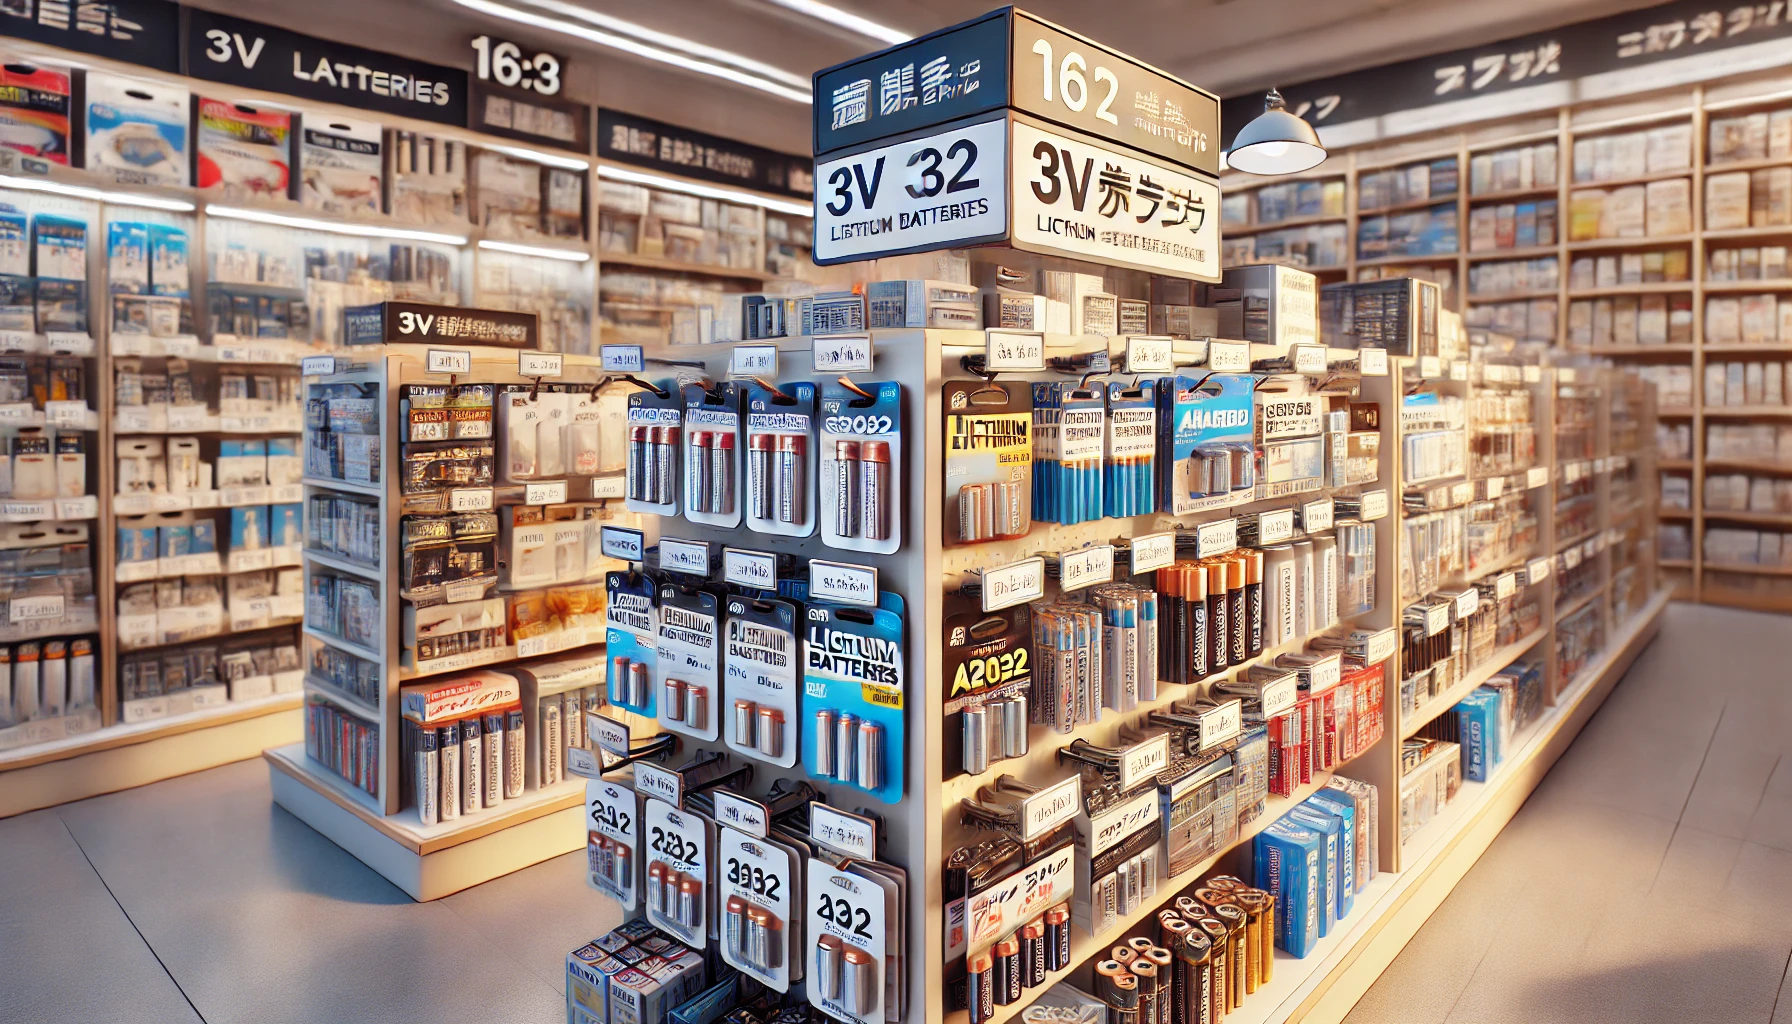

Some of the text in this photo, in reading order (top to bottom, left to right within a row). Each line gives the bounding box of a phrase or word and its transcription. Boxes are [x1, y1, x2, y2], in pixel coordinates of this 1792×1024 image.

[206, 29, 266, 69] 3V
[1032, 38, 1119, 126] 162
[825, 155, 887, 217] 3V
[1030, 140, 1095, 213] 3V
[398, 311, 434, 336] 3V
